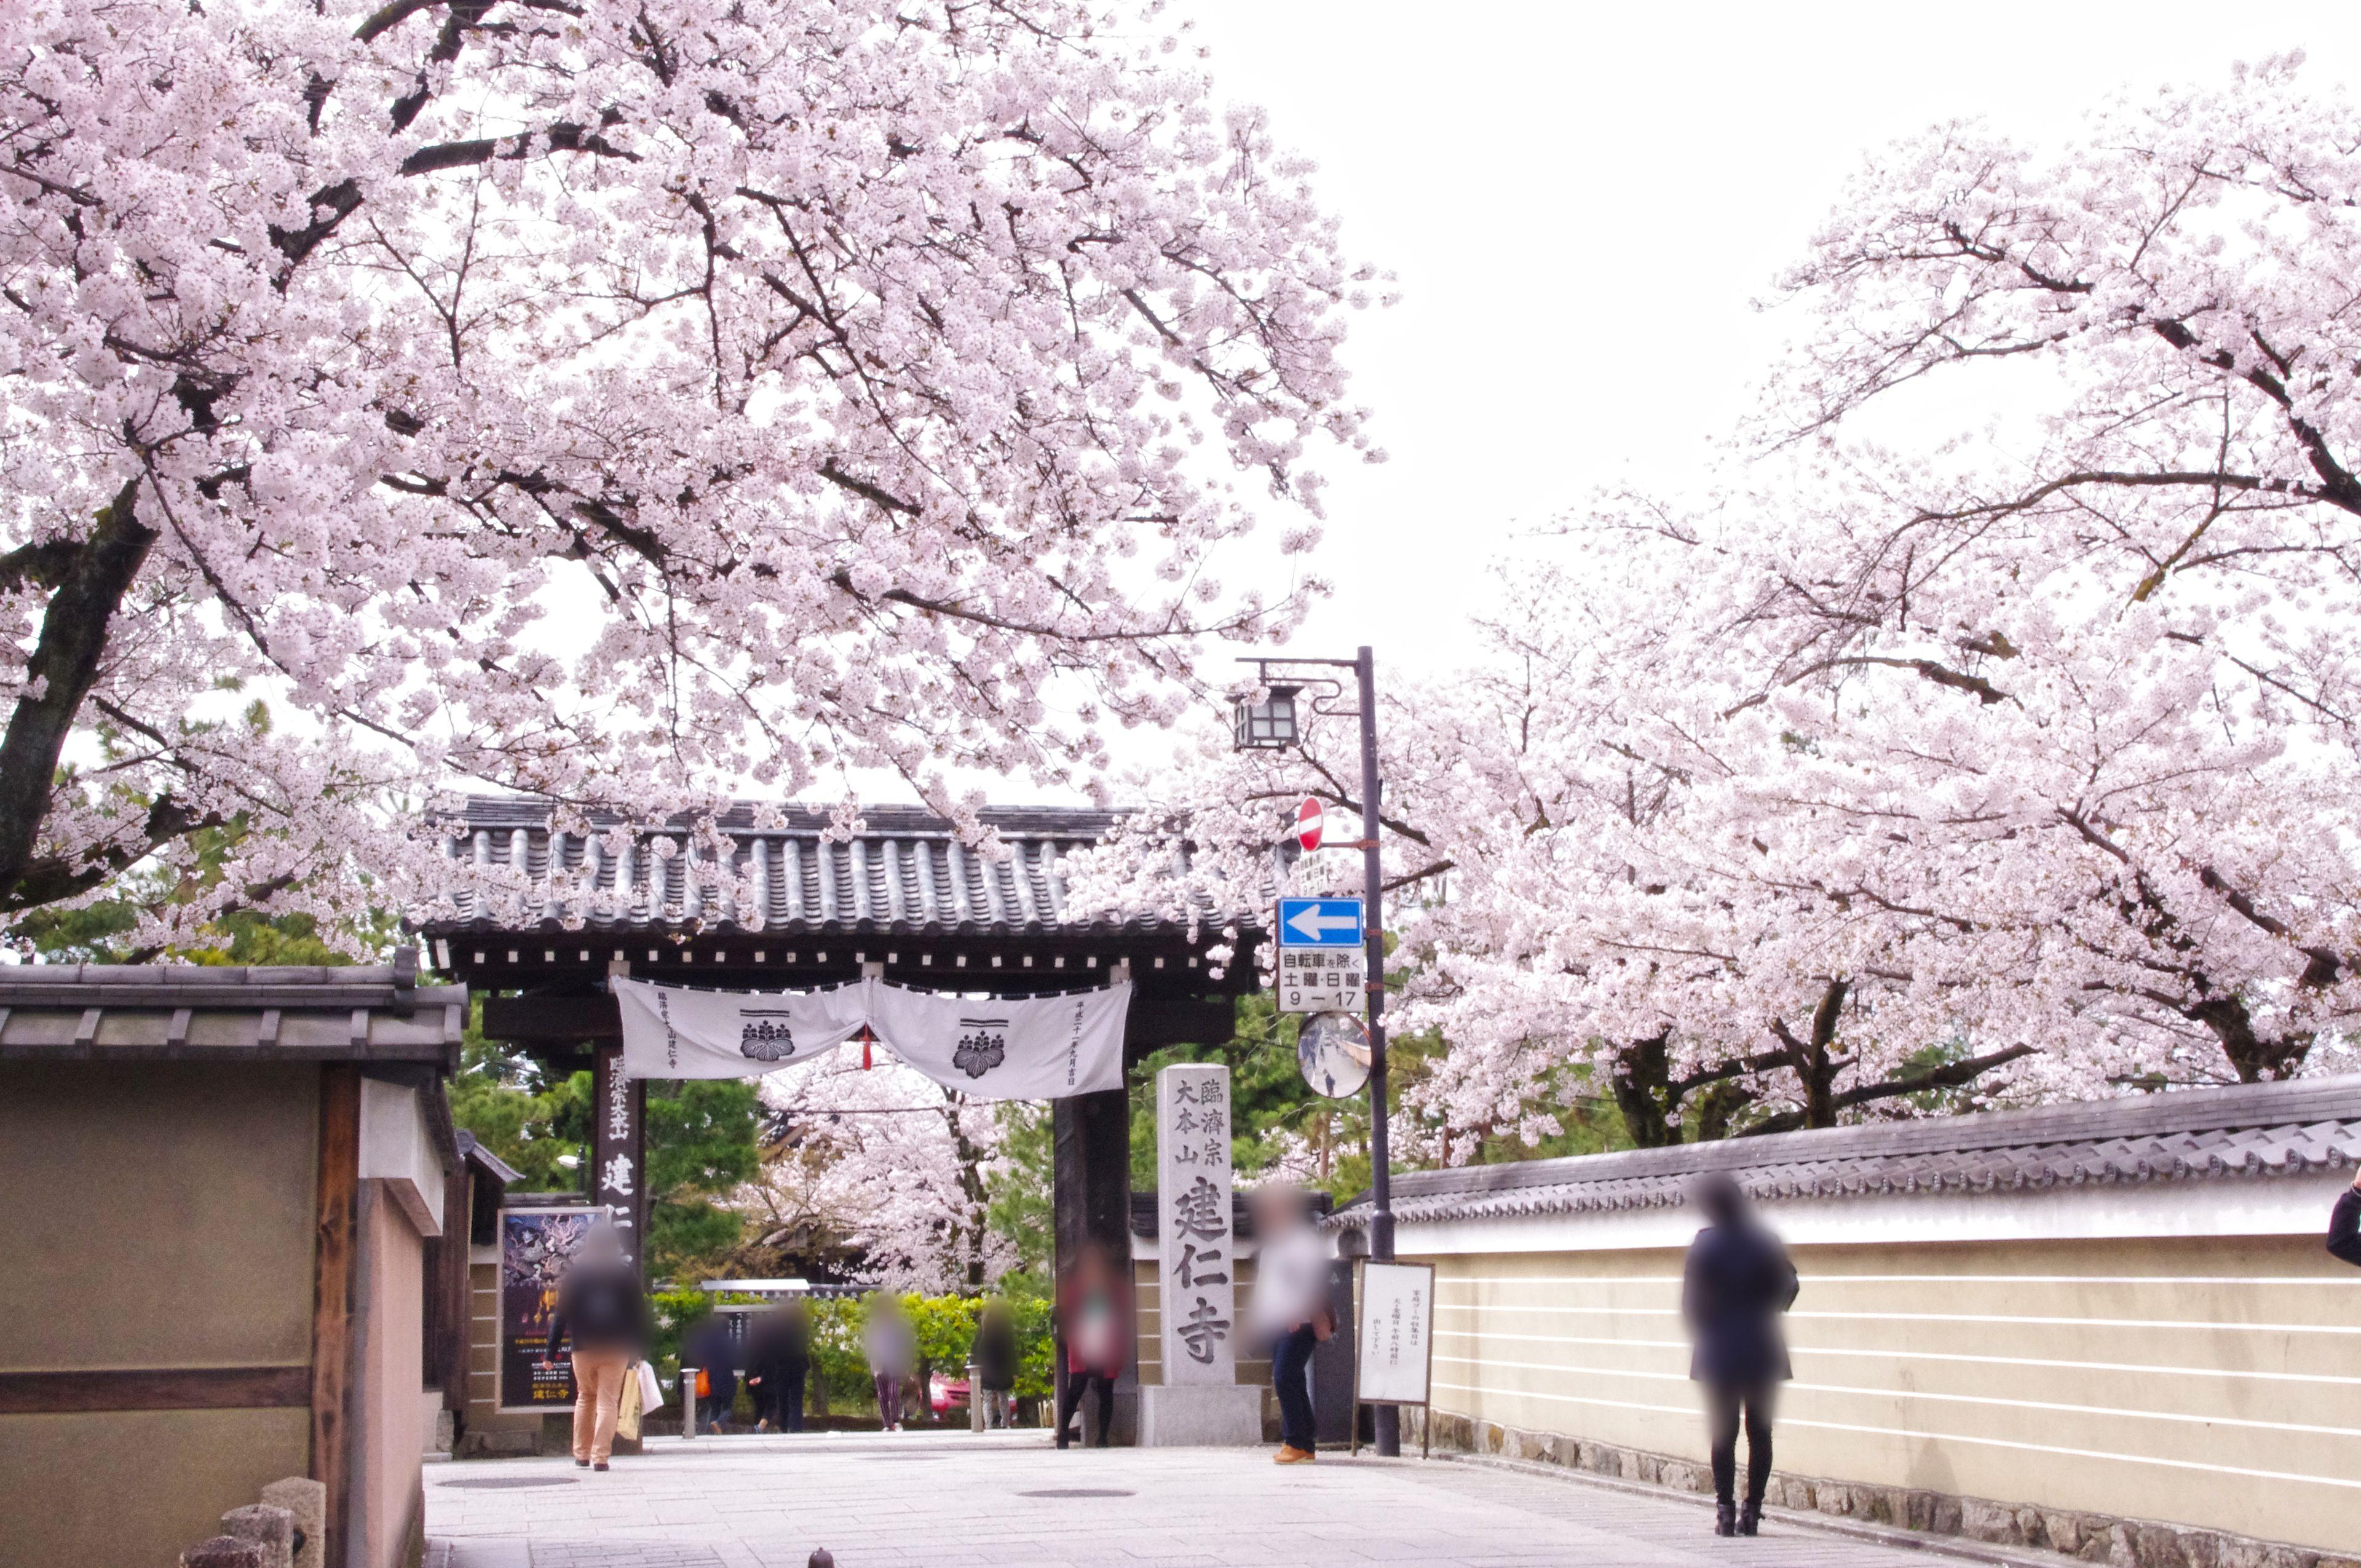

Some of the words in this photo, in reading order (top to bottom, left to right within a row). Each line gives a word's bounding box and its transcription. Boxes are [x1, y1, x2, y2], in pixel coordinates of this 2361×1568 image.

[1284, 953, 1359, 968] 自転車を除く
[1174, 1079, 1199, 1164] 大本山
[1173, 1175, 1231, 1364] 建仁寺
